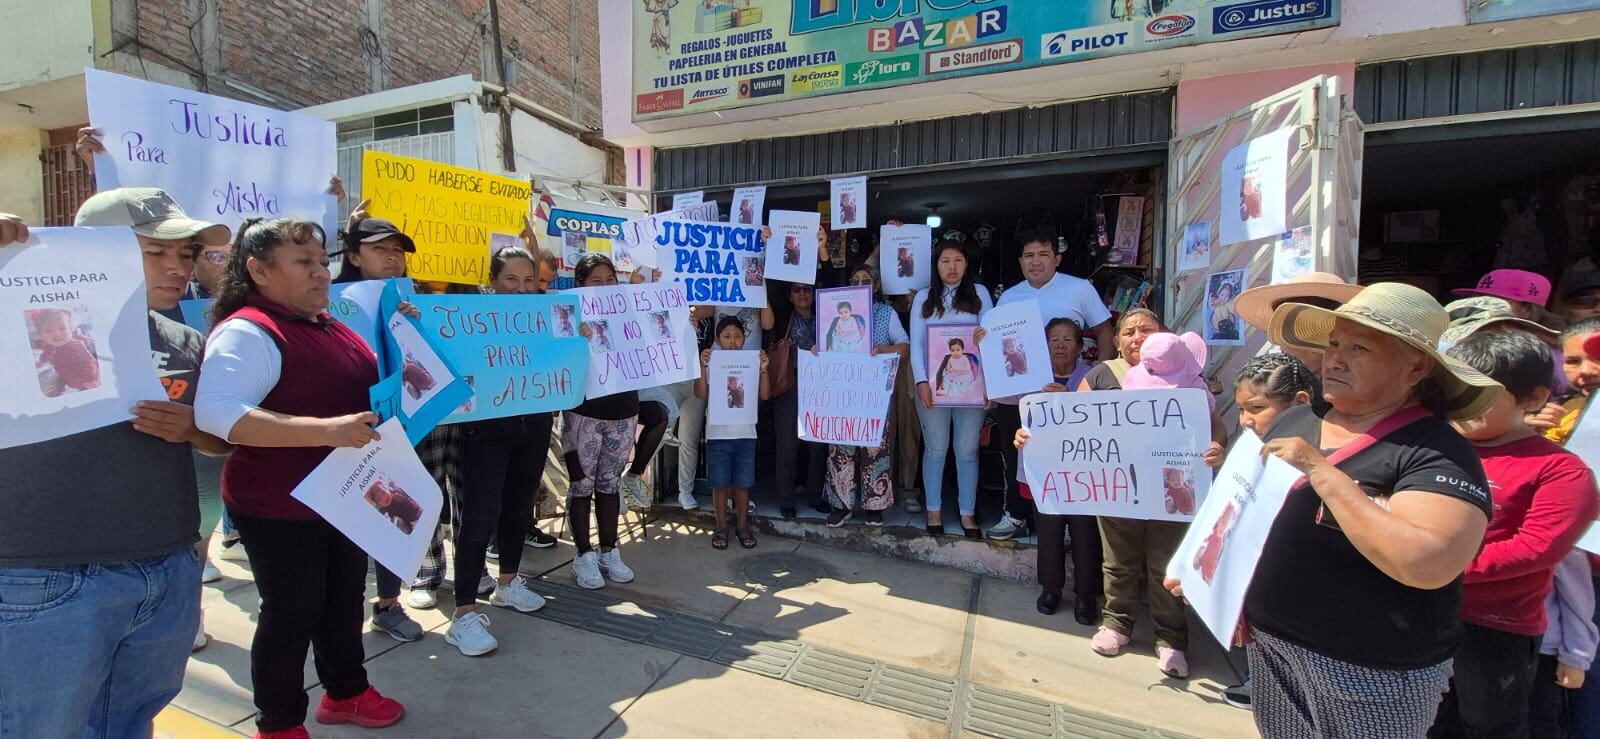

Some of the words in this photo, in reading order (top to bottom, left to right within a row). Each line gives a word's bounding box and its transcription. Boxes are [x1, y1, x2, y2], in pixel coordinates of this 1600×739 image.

[1248, 3, 1317, 23] Justus
[873, 9, 1001, 52] BAZAR
[1071, 32, 1128, 52] PILOT
[680, 38, 722, 54] REGALOS
[724, 49, 738, 64] EN
[739, 41, 787, 62] GENERAL
[953, 45, 1012, 66] Standford
[653, 76, 668, 89] TU
[670, 71, 702, 86] LISTA
[703, 68, 720, 83] DE
[766, 50, 837, 74] COMPLETA
[753, 79, 782, 90] VINIFAN
[121, 131, 168, 165] Para
[375, 158, 415, 182] PUDO
[428, 168, 484, 193] HABERSE
[213, 181, 281, 216] Aisha
[372, 186, 402, 213] NO
[555, 217, 620, 236] COPIAS
[656, 220, 764, 253] JUSTICIA
[674, 249, 740, 275] PARA
[0, 275, 66, 287] USTICIA
[69, 273, 108, 283] PARA
[675, 277, 746, 303] ISHA
[29, 290, 80, 304] AISHA!
[633, 291, 652, 312] ES
[433, 305, 548, 338] JUSTICIA
[624, 320, 642, 341] NO
[483, 344, 531, 368] PARA
[598, 340, 684, 385] MUERTE
[493, 368, 573, 407] AISHA
[1026, 397, 1186, 430] ¡JUSTICIA
[363, 446, 382, 465] PARA
[1061, 437, 1121, 463] PARA
[1042, 463, 1139, 505] AISHA!
